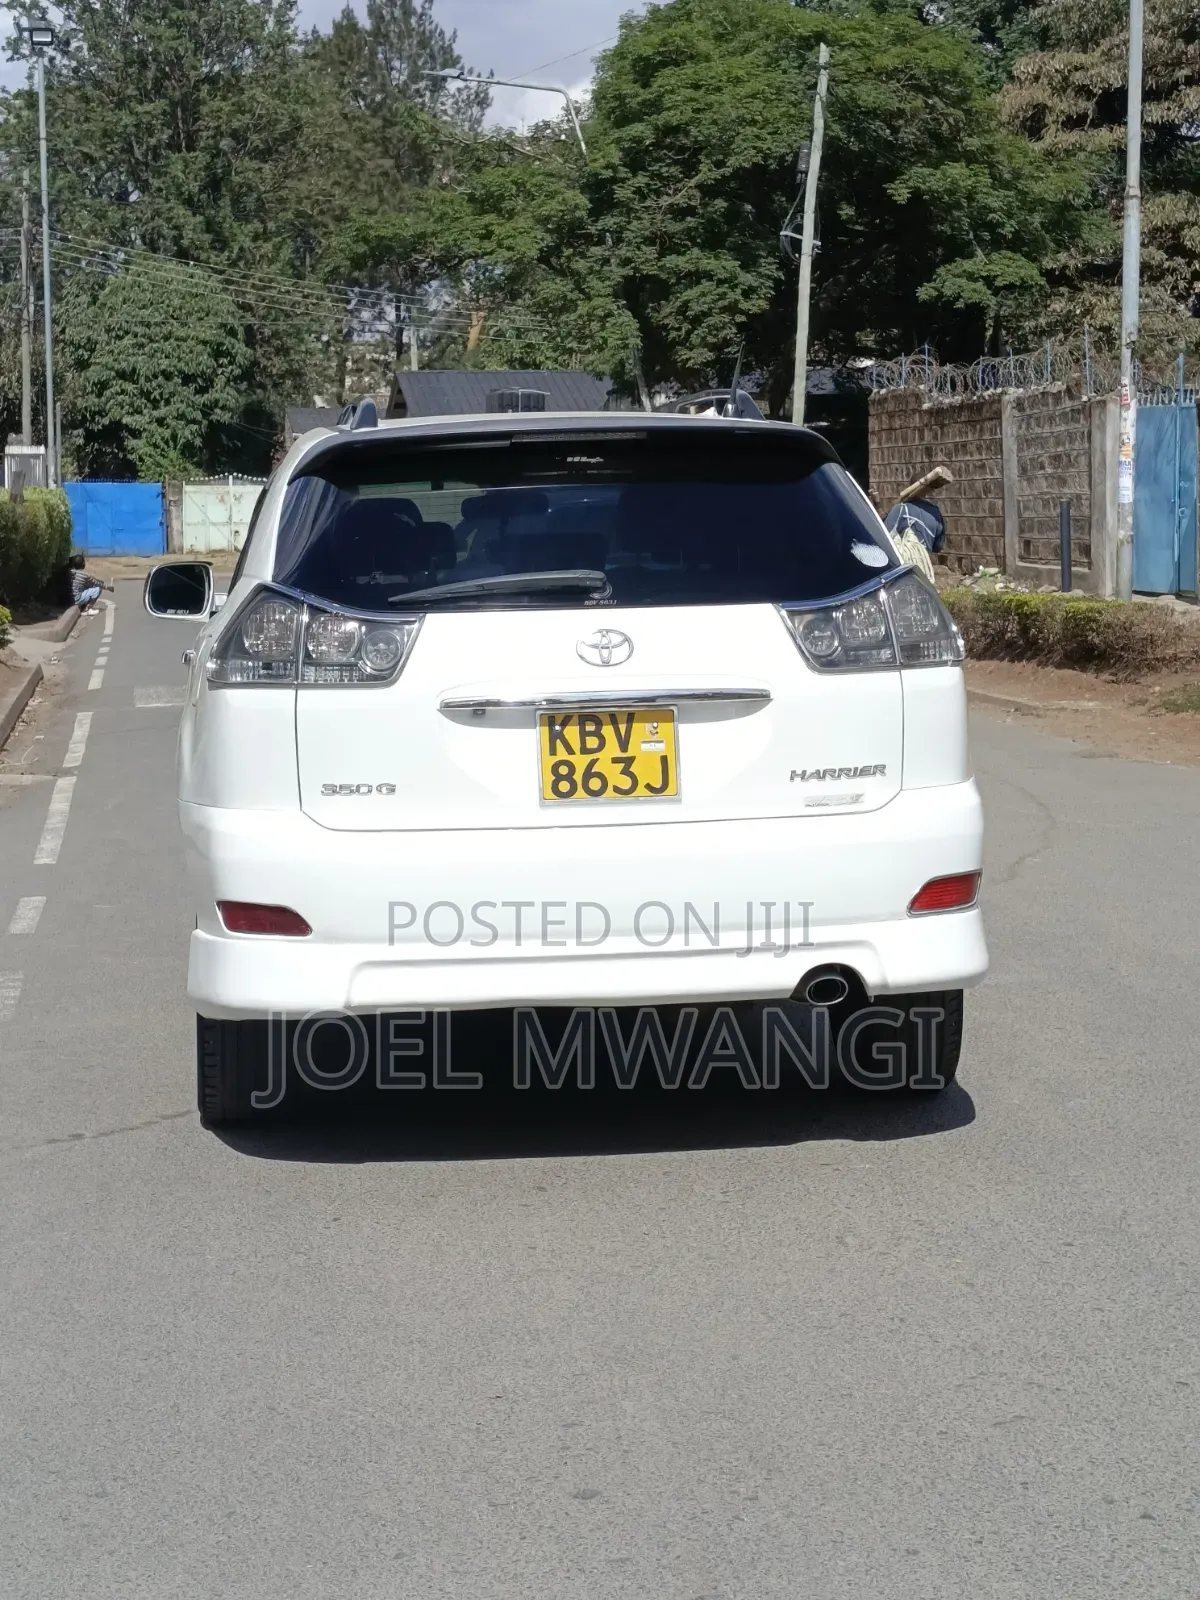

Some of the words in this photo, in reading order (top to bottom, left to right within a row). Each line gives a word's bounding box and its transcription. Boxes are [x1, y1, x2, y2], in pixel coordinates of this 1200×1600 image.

[548, 712, 636, 757] KBV
[550, 754, 670, 799] 863J
[789, 764, 887, 782] HARRIER
